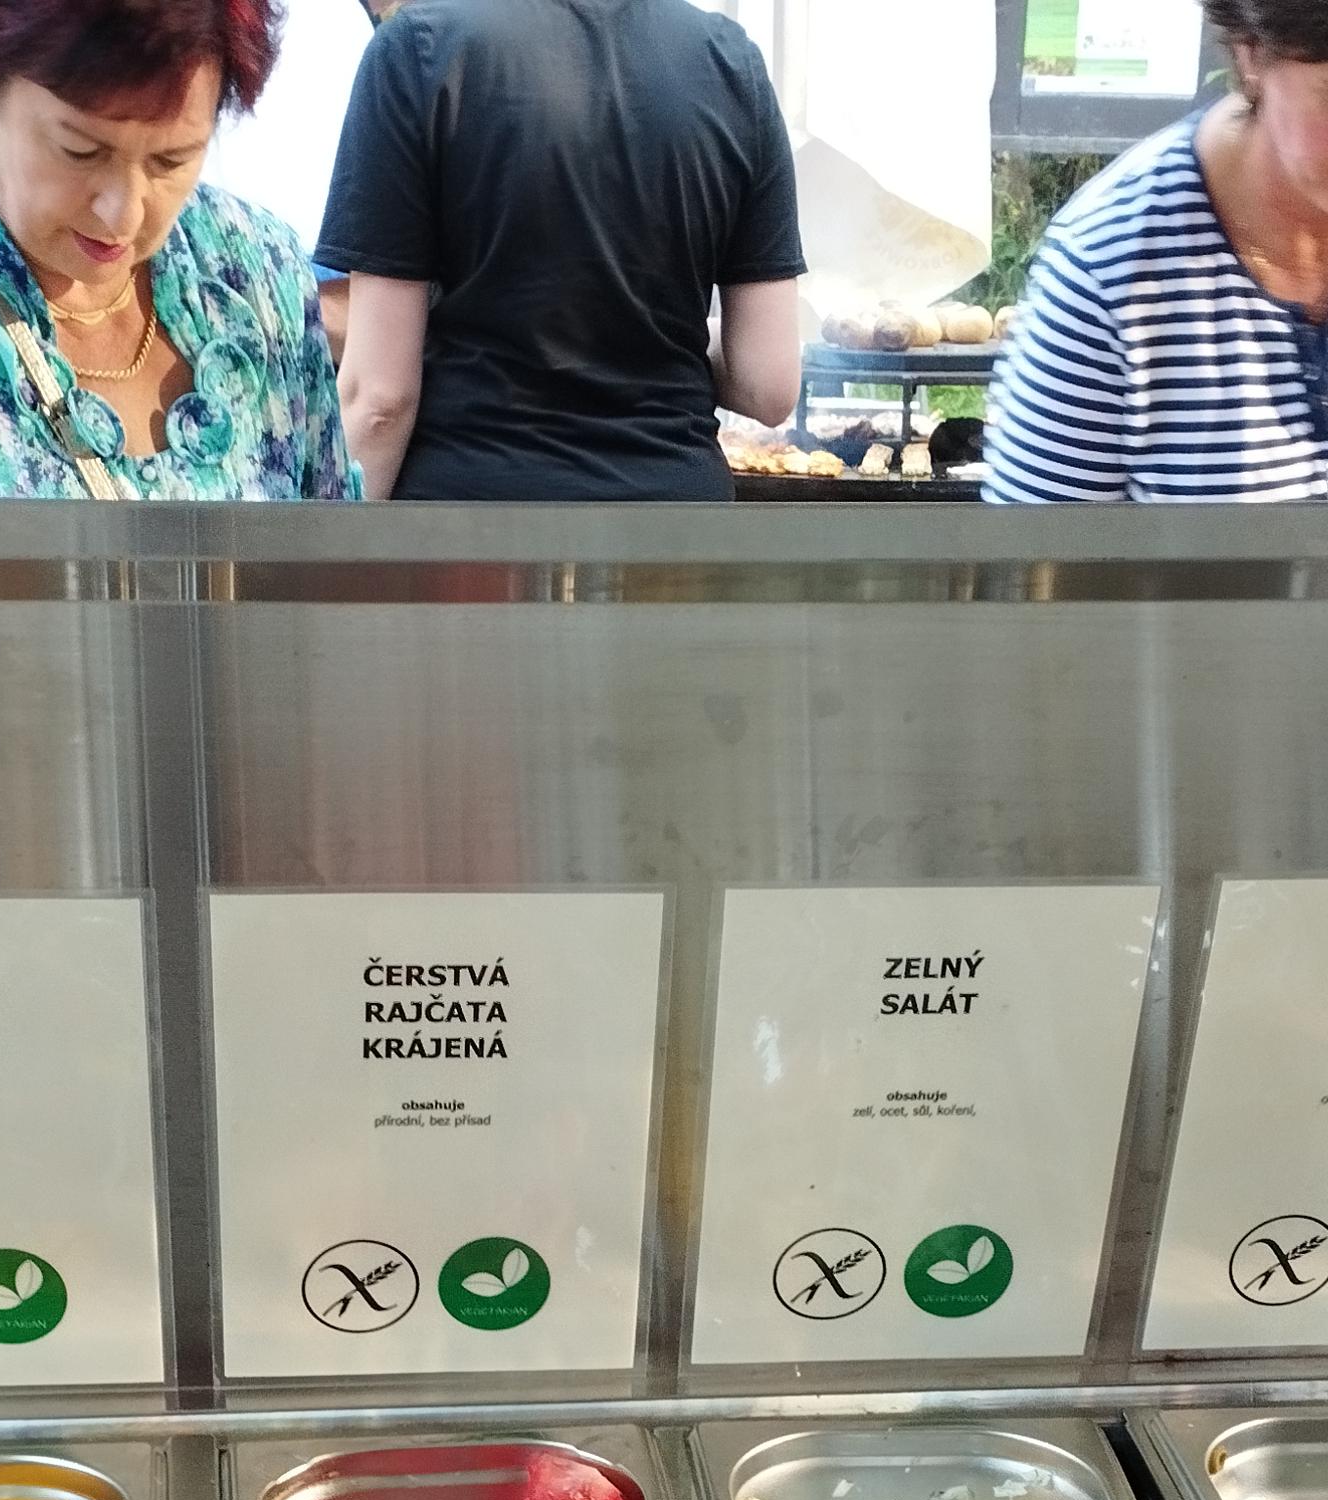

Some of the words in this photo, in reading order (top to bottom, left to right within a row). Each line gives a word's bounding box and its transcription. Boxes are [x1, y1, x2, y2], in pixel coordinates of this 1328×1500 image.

[362, 956, 510, 988] ČERSTVÁ
[883, 950, 985, 979] ZELNÝ
[364, 993, 508, 1023] RAJČATA
[880, 985, 979, 1016] SALÁT
[362, 1029, 508, 1059] KRÁJENÁ
[401, 1099, 465, 1112] obsahuje
[886, 1090, 947, 1103] obsahuje
[429, 1115, 450, 1126] bez
[454, 1113, 491, 1128] přísad
